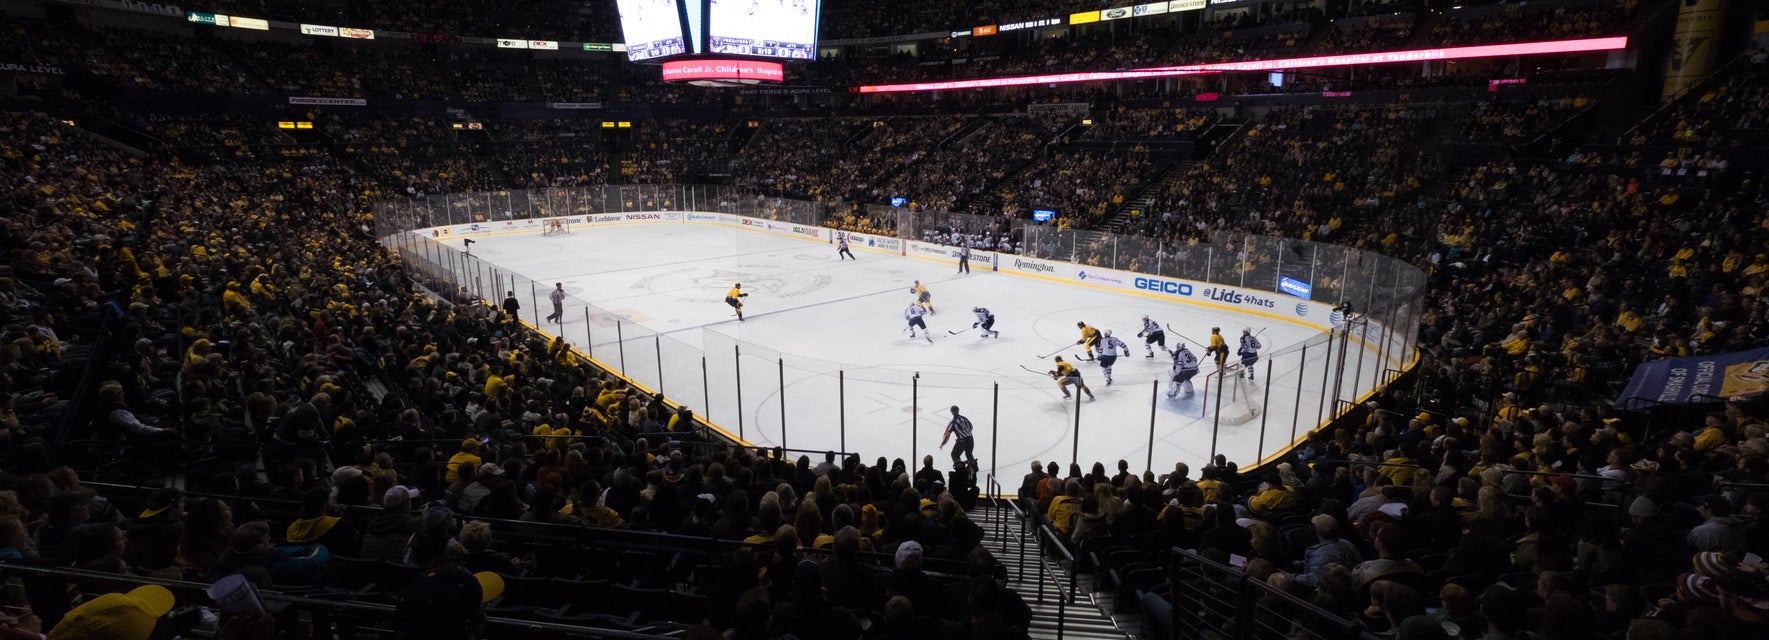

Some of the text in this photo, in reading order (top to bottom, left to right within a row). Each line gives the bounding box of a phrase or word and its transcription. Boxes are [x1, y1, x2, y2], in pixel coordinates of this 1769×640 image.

[999, 22, 1024, 31] NISSAN
[1278, 57, 1325, 67] Children's
[1328, 56, 1370, 65] Hospital
[1387, 50, 1445, 61] Vanderbilt
[30, 65, 66, 75] LEVEL
[741, 218, 753, 226] DEX
[1014, 258, 1055, 273] Remington
[1134, 277, 1193, 297] GEICO
[1107, 340, 1113, 350] 5
